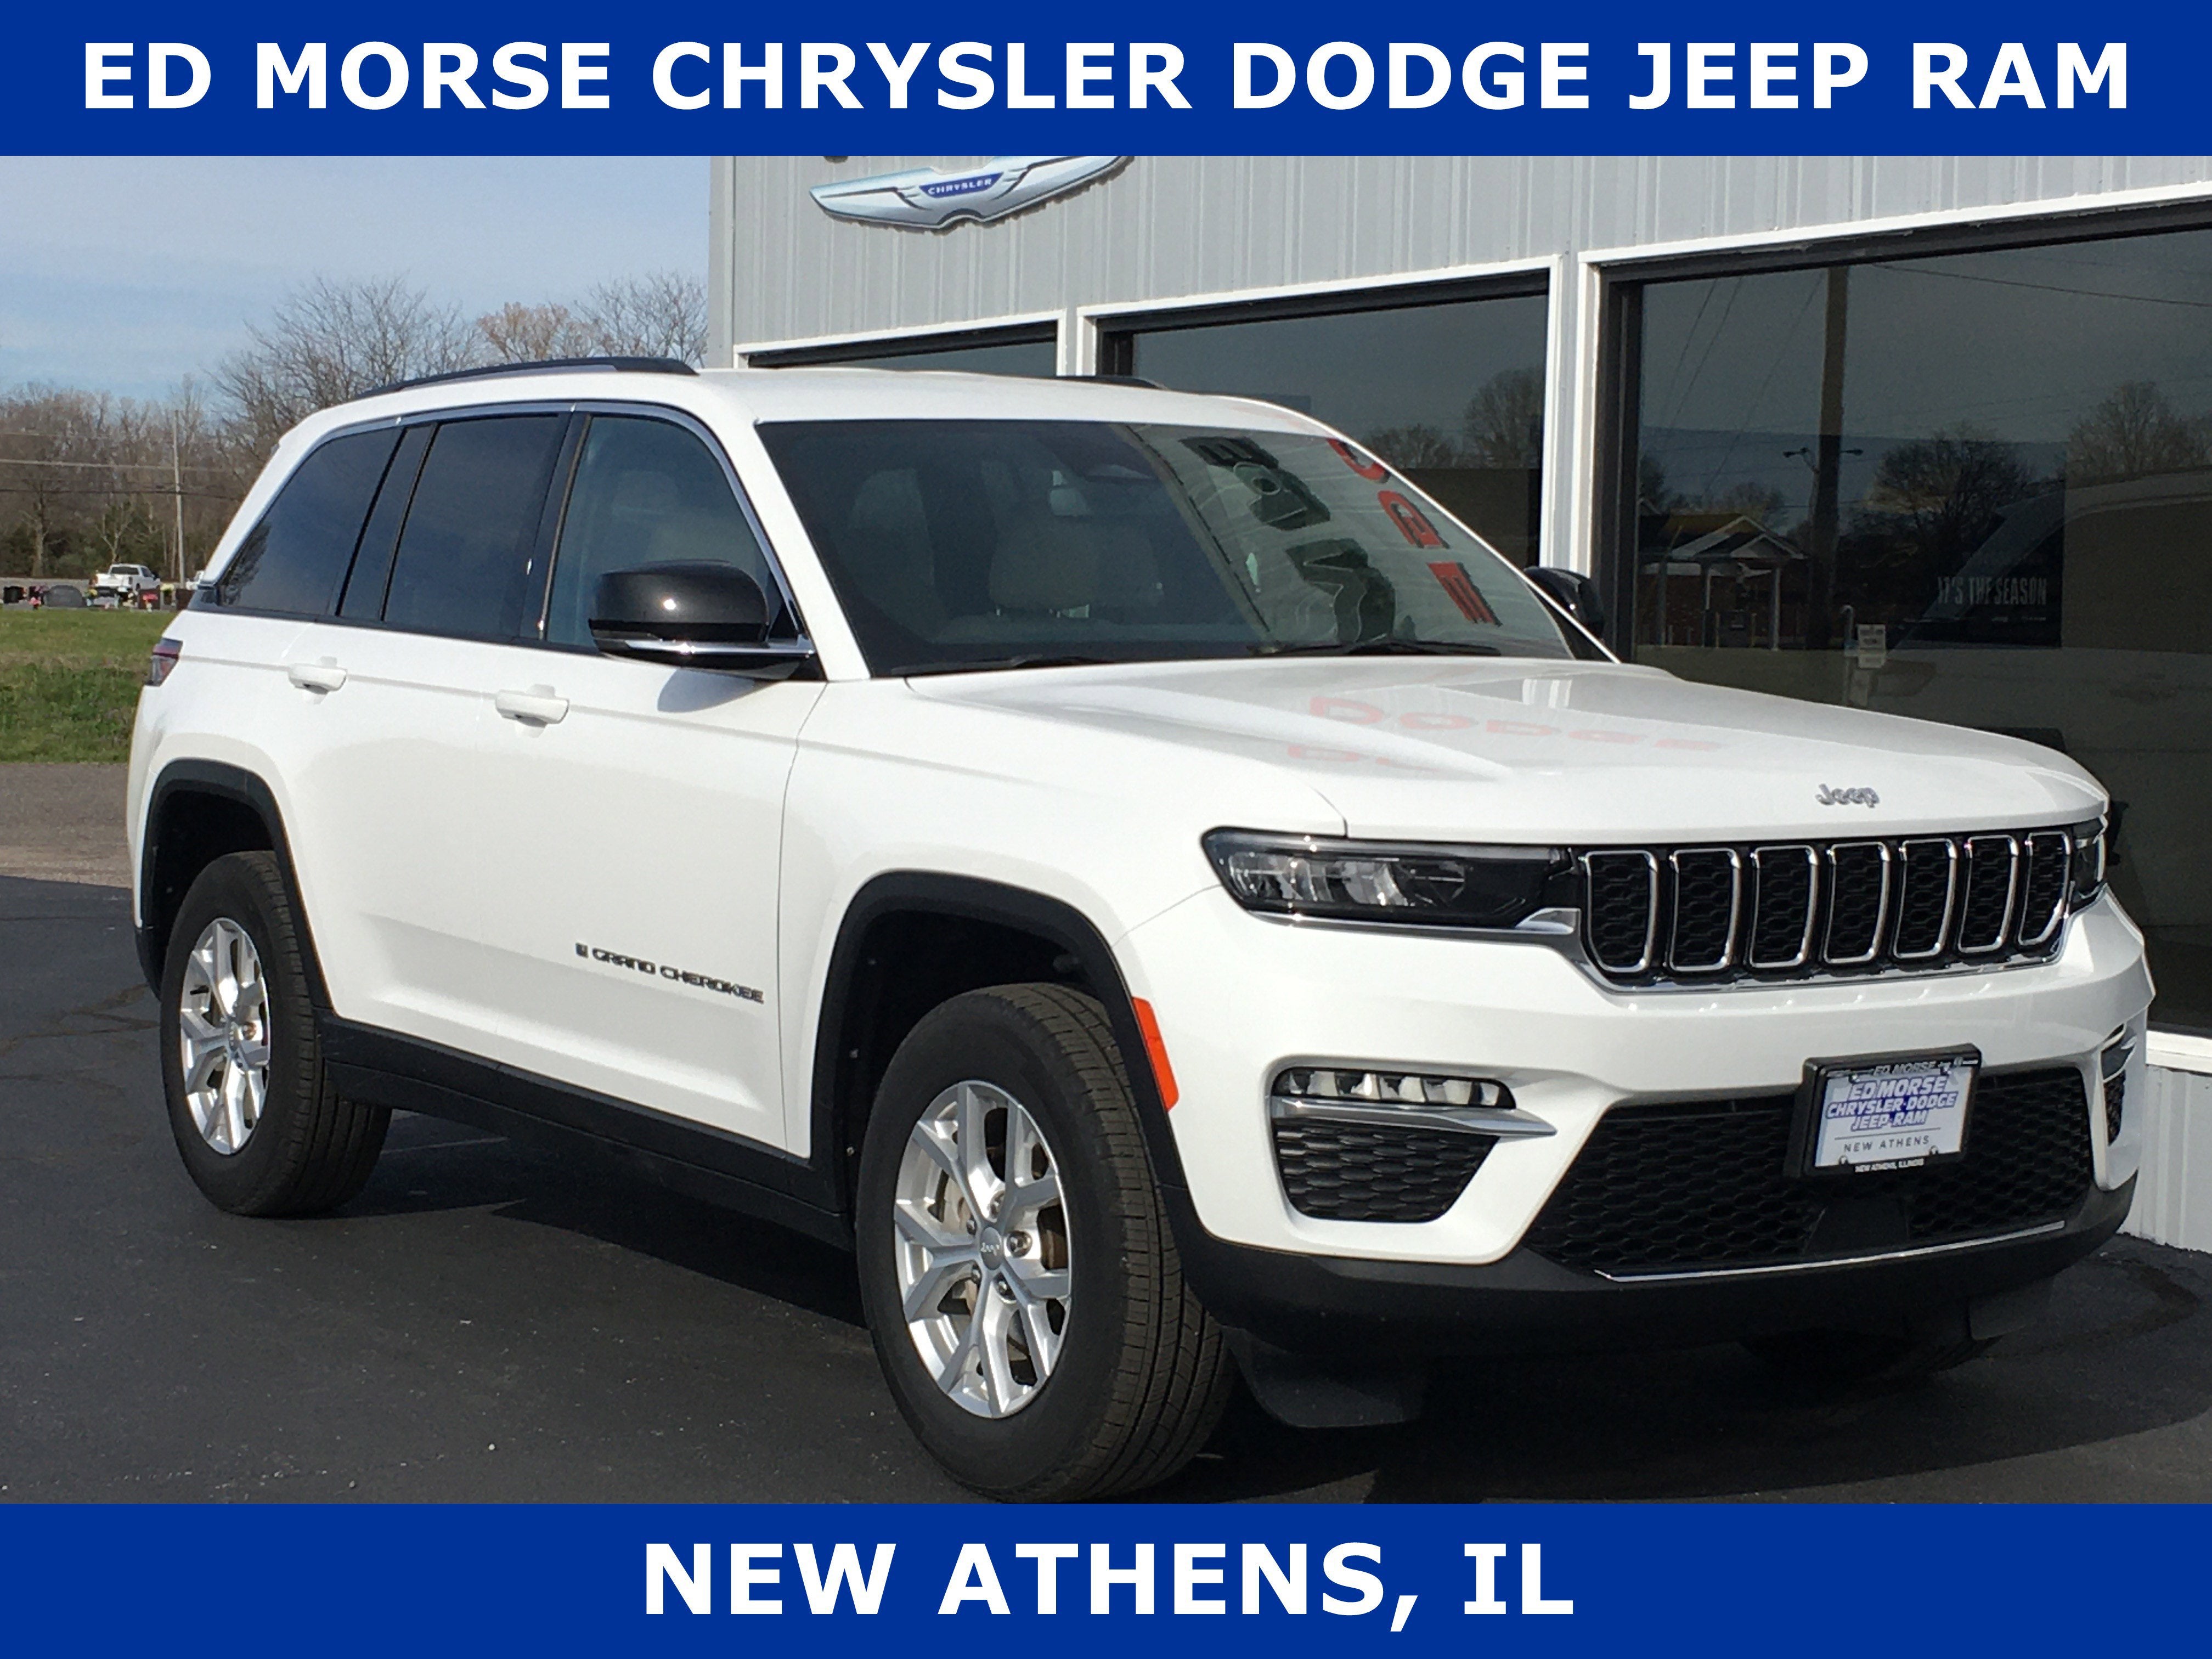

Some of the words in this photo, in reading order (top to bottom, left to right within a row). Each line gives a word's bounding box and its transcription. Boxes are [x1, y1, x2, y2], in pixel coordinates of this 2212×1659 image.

[928, 178, 991, 194] CHRYSLER
[1994, 577, 2047, 605] SEASON
[1815, 783, 1880, 808] Jeep
[592, 947, 656, 974] GRAND
[660, 965, 764, 1005] CHEROKEE
[1848, 1082, 1876, 1099] ED
[1878, 1076, 1949, 1098] MORSE
[1844, 1142, 1872, 1152] NEW
[1879, 1135, 1929, 1149] ATHENS
